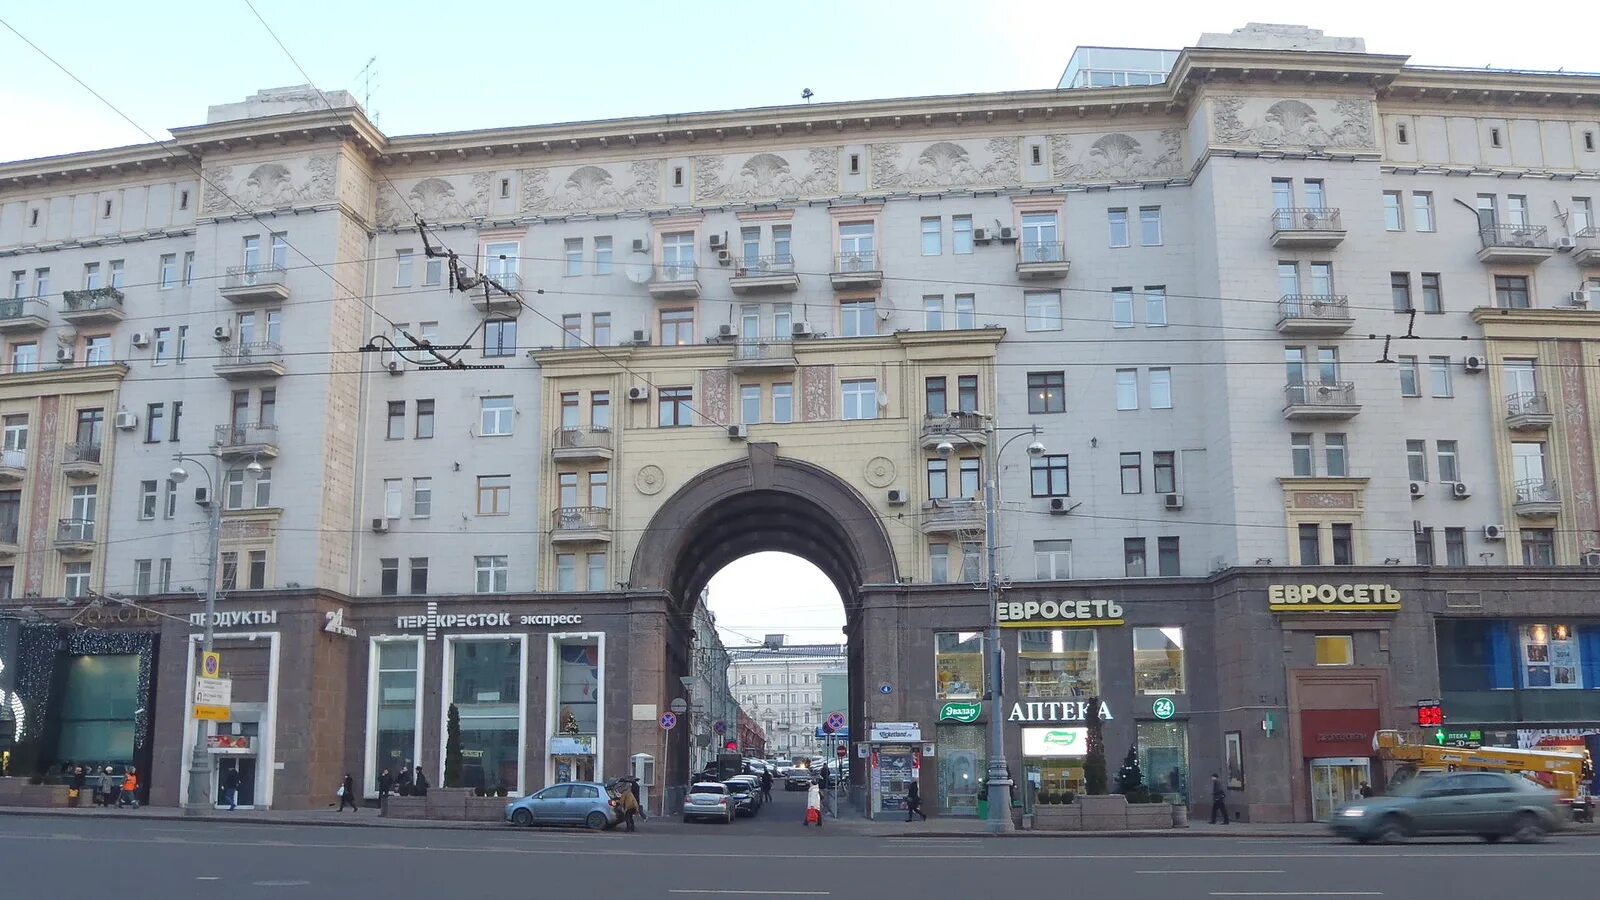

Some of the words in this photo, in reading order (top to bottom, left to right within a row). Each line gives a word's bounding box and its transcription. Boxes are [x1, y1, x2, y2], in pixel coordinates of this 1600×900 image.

[1268, 583, 1401, 604] ЕВРОСЕТЬ
[997, 599, 1123, 620] ЕВРОСЕТЬ
[325, 607, 344, 634] 24
[520, 614, 582, 627] экспресс
[945, 706, 976, 717] Эвалар
[1156, 701, 1171, 711] 24
